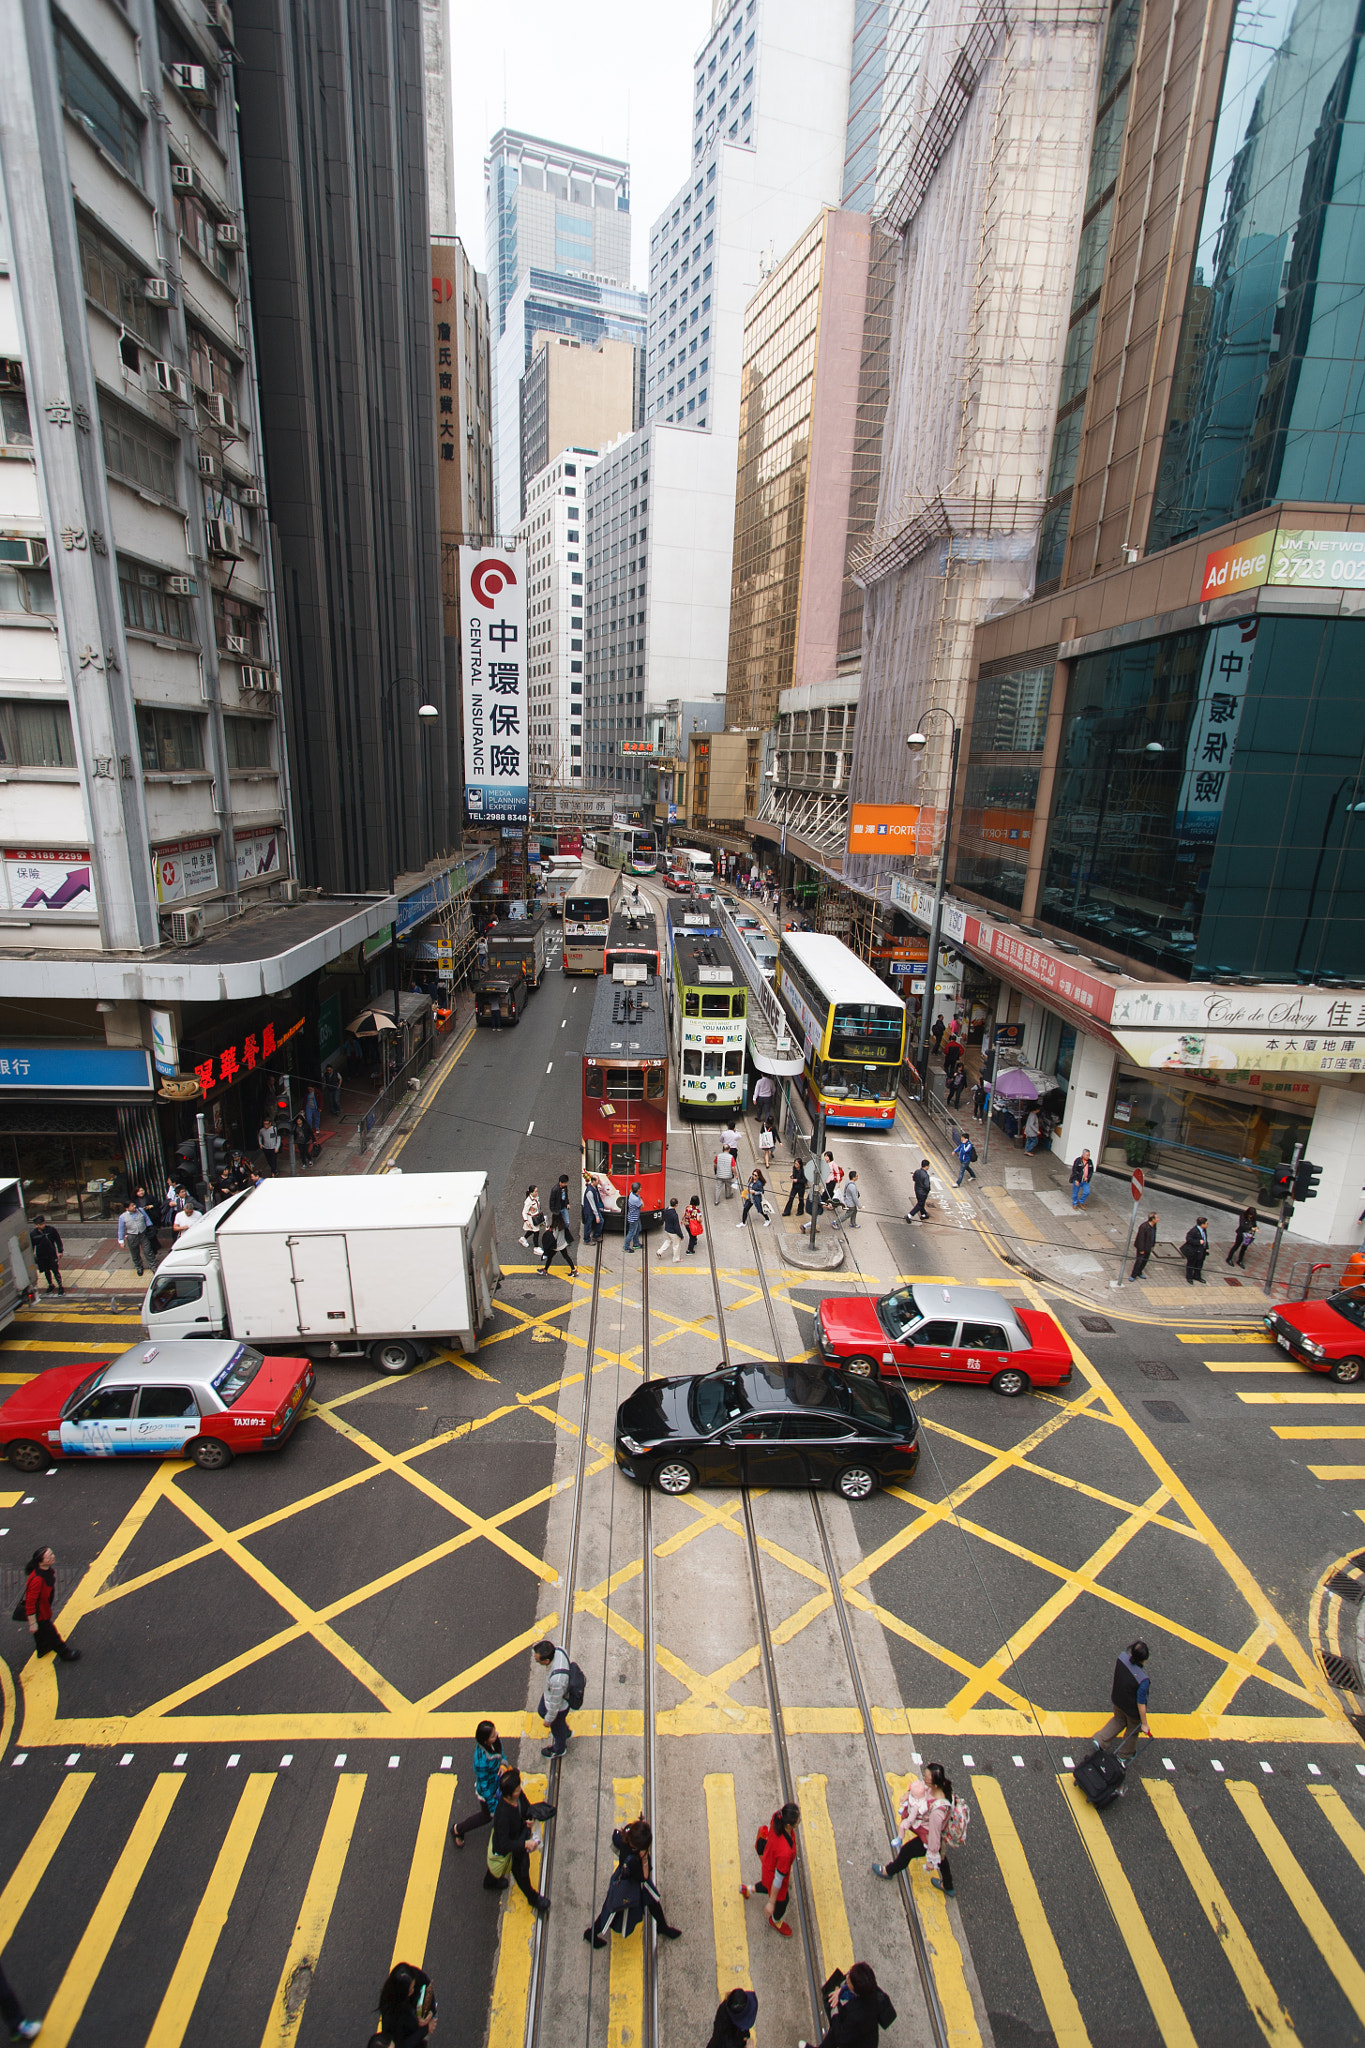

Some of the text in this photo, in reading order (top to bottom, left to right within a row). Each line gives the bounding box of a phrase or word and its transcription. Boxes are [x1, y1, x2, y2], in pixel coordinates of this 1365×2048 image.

[1280, 540, 1365, 551] JM NETWO
[1206, 554, 1267, 590] Ad Here
[1275, 558, 1326, 580] 2723
[470, 617, 484, 775] CENTRAL INSURANCE
[488, 618, 521, 777] 中環保險
[889, 825, 932, 836] FORTRESS
[31, 851, 83, 860] 3188 2299
[17, 867, 41, 879] 保險
[919, 896, 932, 914] SUN
[1204, 994, 1318, 1030] Café de Savoy
[685, 1033, 702, 1042] M&G
[726, 1034, 742, 1042] M&G
[1266, 1039, 1356, 1051] 本大廈地庫
[876, 1046, 887, 1057] 10
[588, 1058, 596, 1066] 93
[1320, 1056, 1365, 1070] 訂座電
[688, 1080, 706, 1090] M&G
[718, 1081, 736, 1090] M&G
[233, 1418, 266, 1426] TAXI 的士
